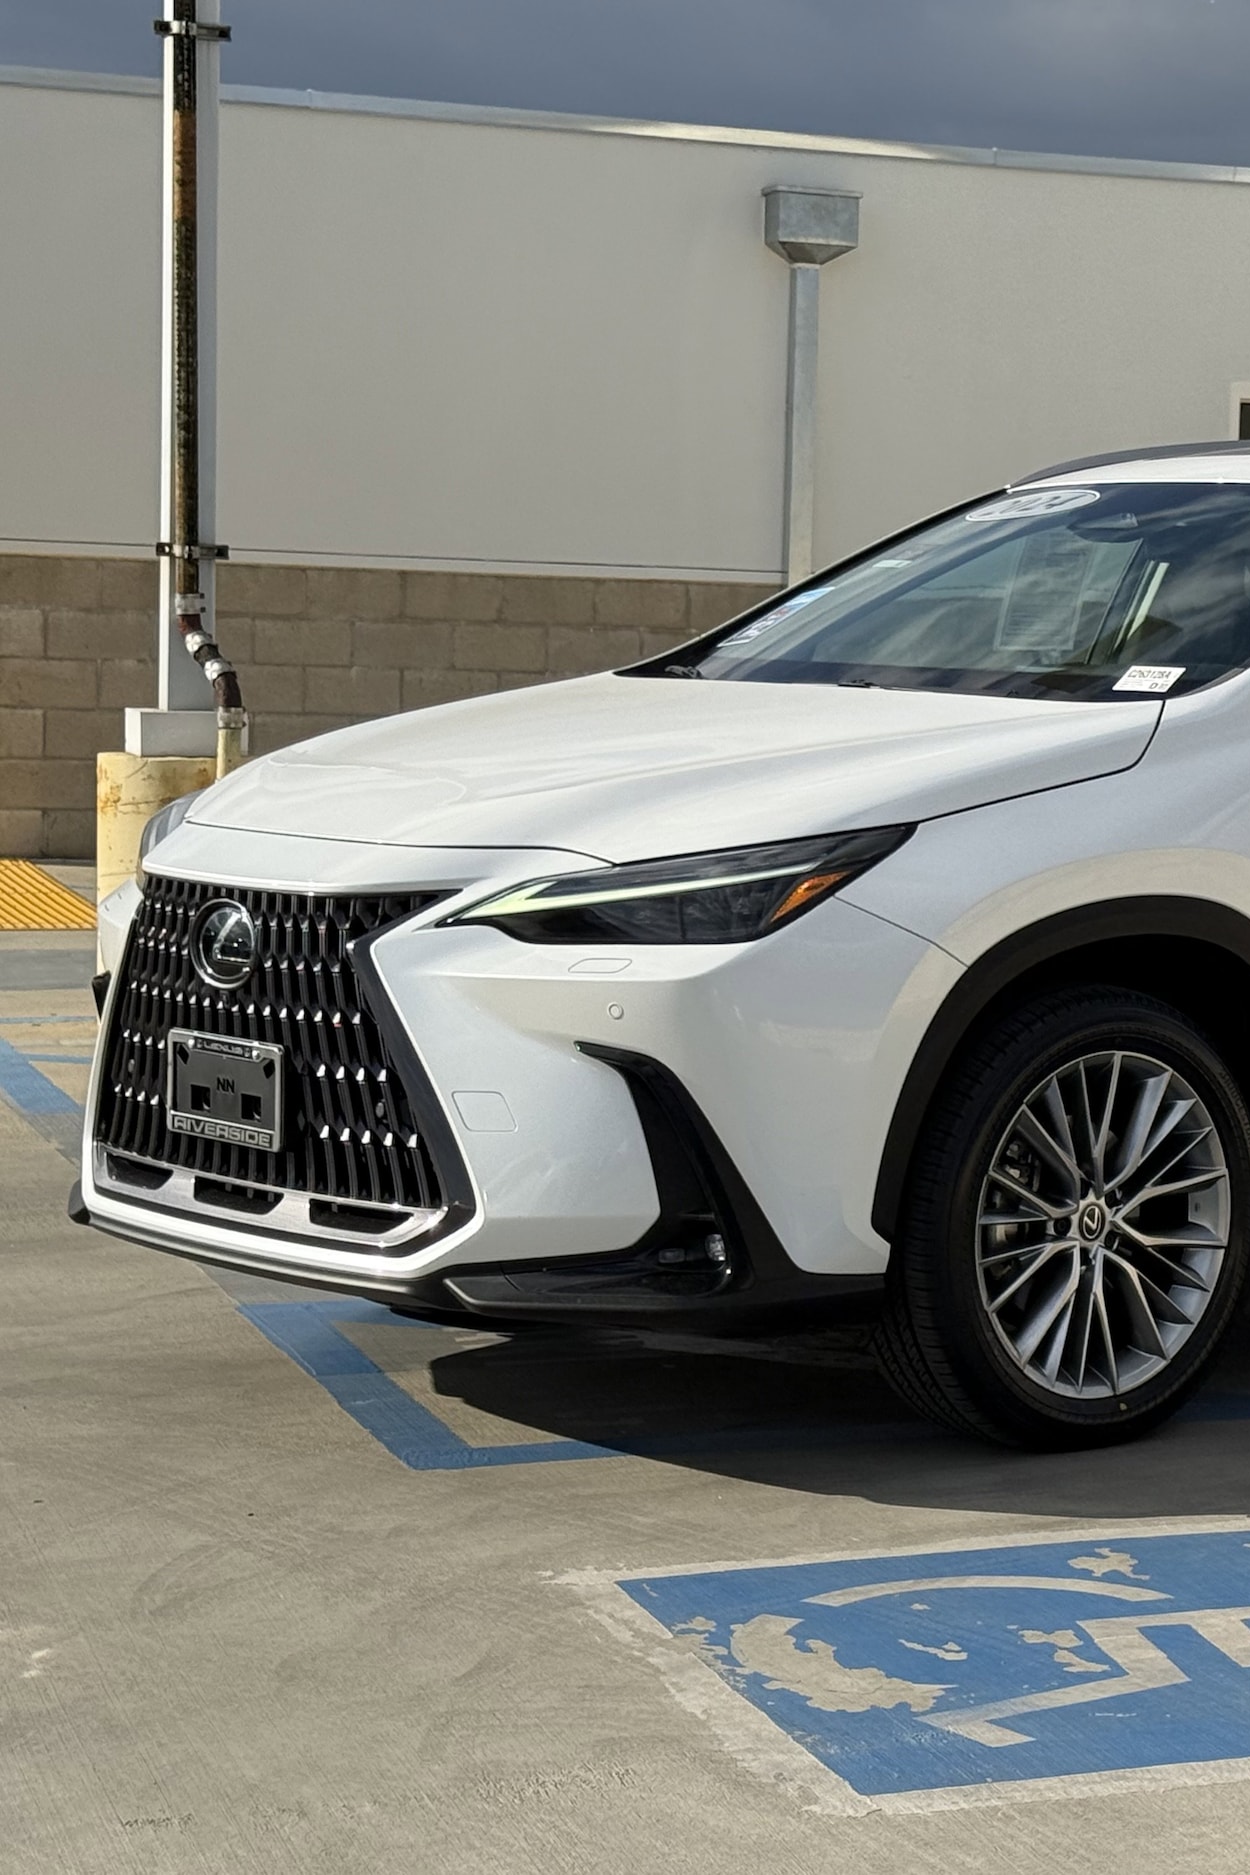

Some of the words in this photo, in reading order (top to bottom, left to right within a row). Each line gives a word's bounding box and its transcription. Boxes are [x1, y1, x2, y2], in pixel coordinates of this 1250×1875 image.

[203, 1040, 244, 1056] LEXUS
[216, 1077, 235, 1094] NN
[174, 1116, 271, 1147] RIVERSIDE
